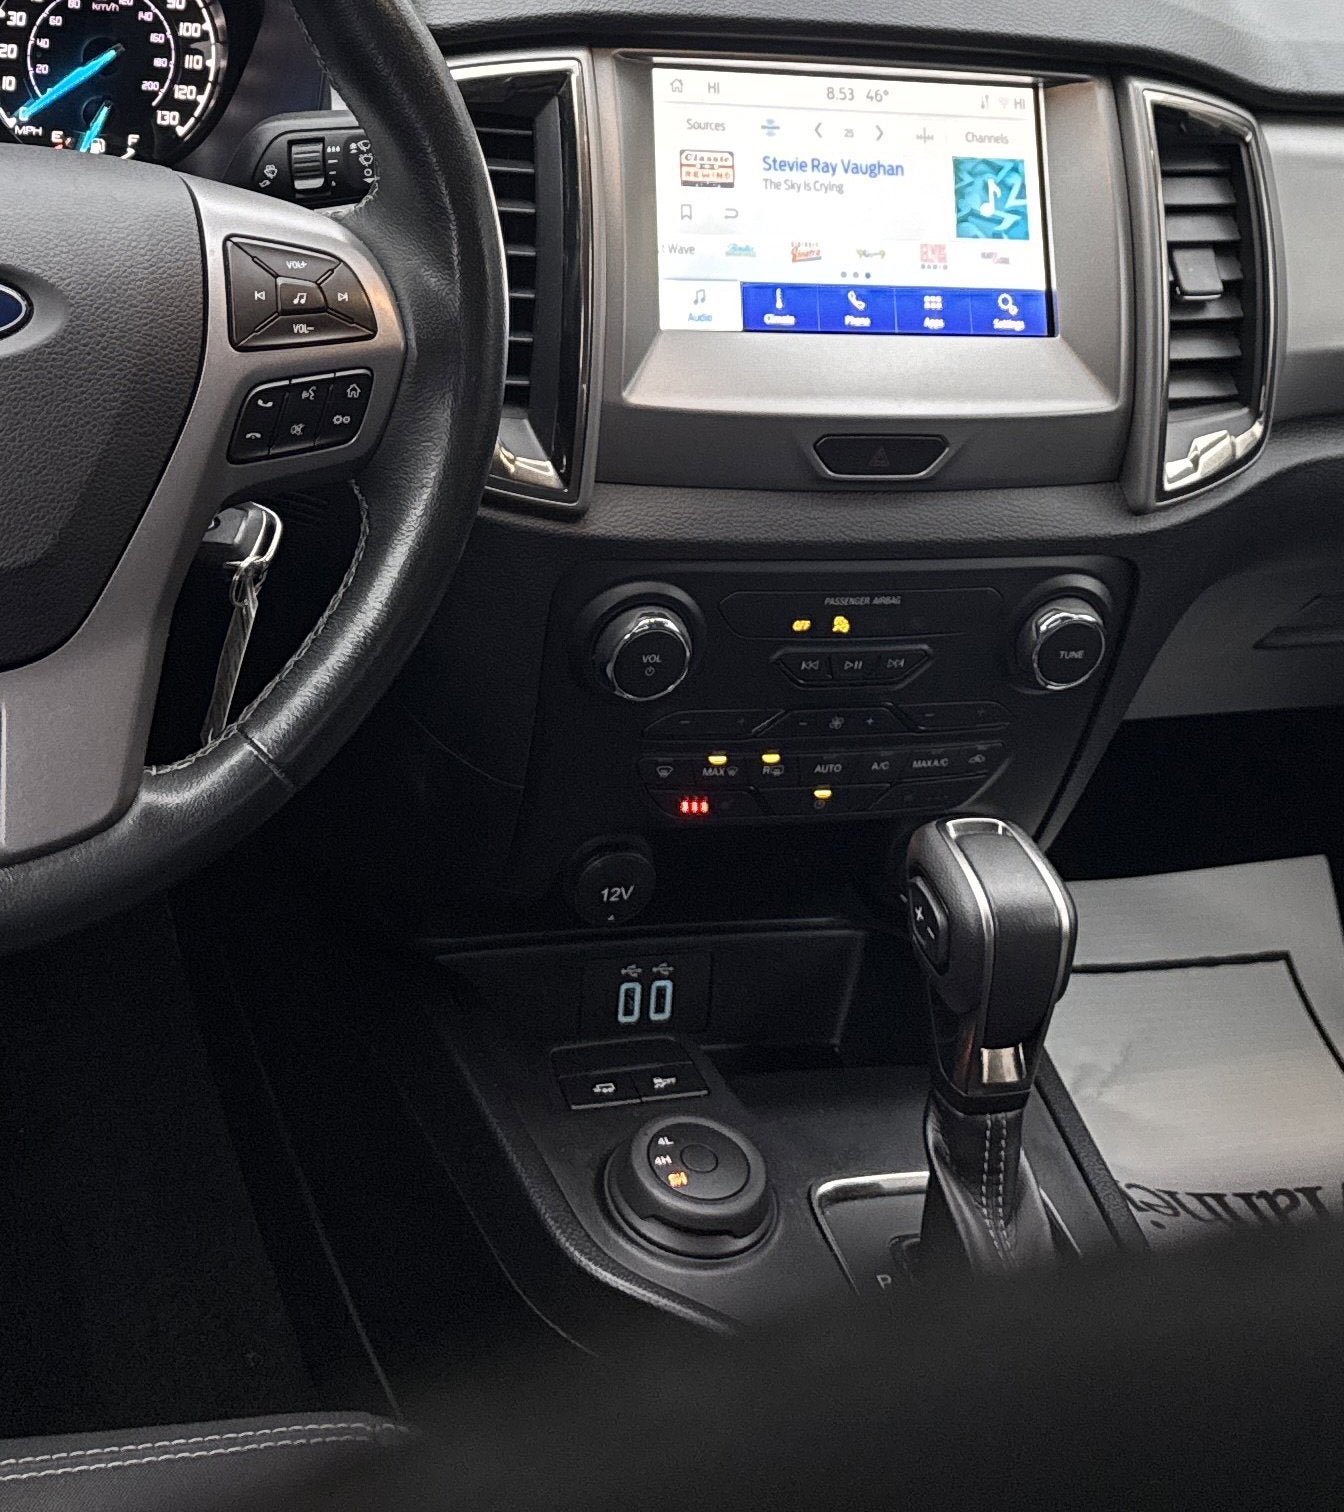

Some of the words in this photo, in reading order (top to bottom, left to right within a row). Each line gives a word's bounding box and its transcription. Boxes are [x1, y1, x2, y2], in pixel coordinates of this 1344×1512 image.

[91, 1, 120, 12] km/h
[6, 11, 27, 27] 30
[48, 15, 62, 27] 60
[179, 22, 202, 37] 100
[36, 37, 50, 49] 40
[184, 54, 204, 70] 110
[35, 63, 49, 75] 20
[1, 75, 16, 91] 10
[141, 80, 160, 91] 200
[174, 84, 197, 100] 120
[156, 109, 180, 126] 130
[14, 125, 43, 136] MPH
[686, 118, 726, 132] Sources
[965, 131, 1010, 145] Channels
[762, 155, 808, 172] Stevie
[811, 158, 838, 176] Ray
[841, 159, 905, 178] Vaughan
[762, 178, 782, 191] The
[784, 179, 802, 193] Sky
[813, 181, 844, 194] Crying
[668, 244, 696, 255] Wave
[687, 312, 713, 323] Audio
[824, 597, 871, 606] PASSENGER
[642, 654, 662, 664] VOL
[1059, 650, 1085, 660] TUNE
[702, 766, 726, 777] MAX
[814, 763, 843, 774] AUTO
[870, 761, 890, 771] A/C
[600, 884, 635, 903] 12V
[657, 1136, 674, 1145] 4L
[875, 1274, 893, 1289] P
